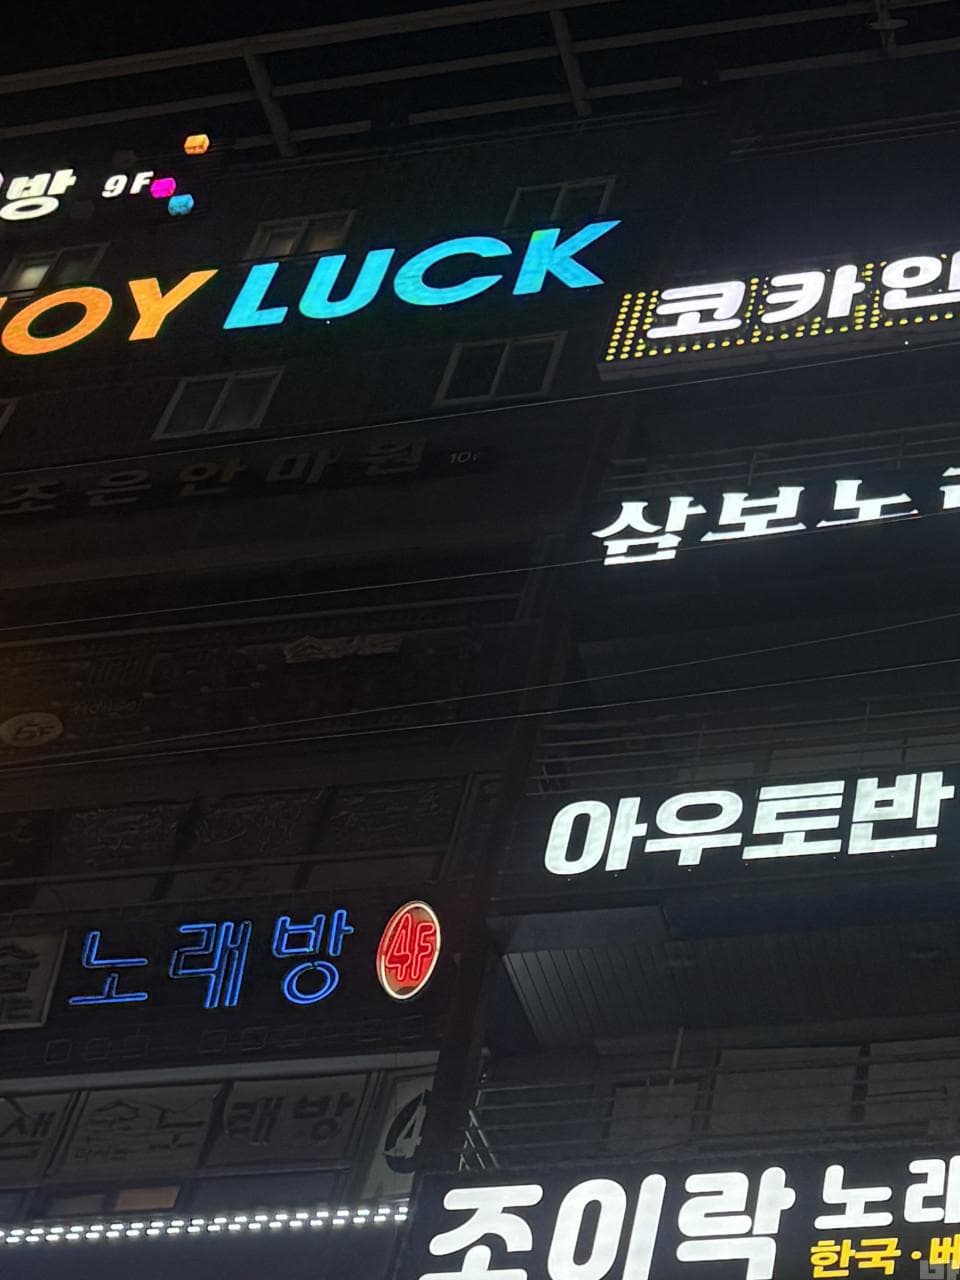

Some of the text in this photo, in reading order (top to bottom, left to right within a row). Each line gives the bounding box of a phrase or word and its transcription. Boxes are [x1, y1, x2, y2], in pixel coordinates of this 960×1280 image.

[0, 168, 154, 221] 방 9F
[0, 220, 622, 356] OY LUCK
[544, 770, 956, 876] 아우토반
[68, 907, 436, 1010] 노래방 4F
